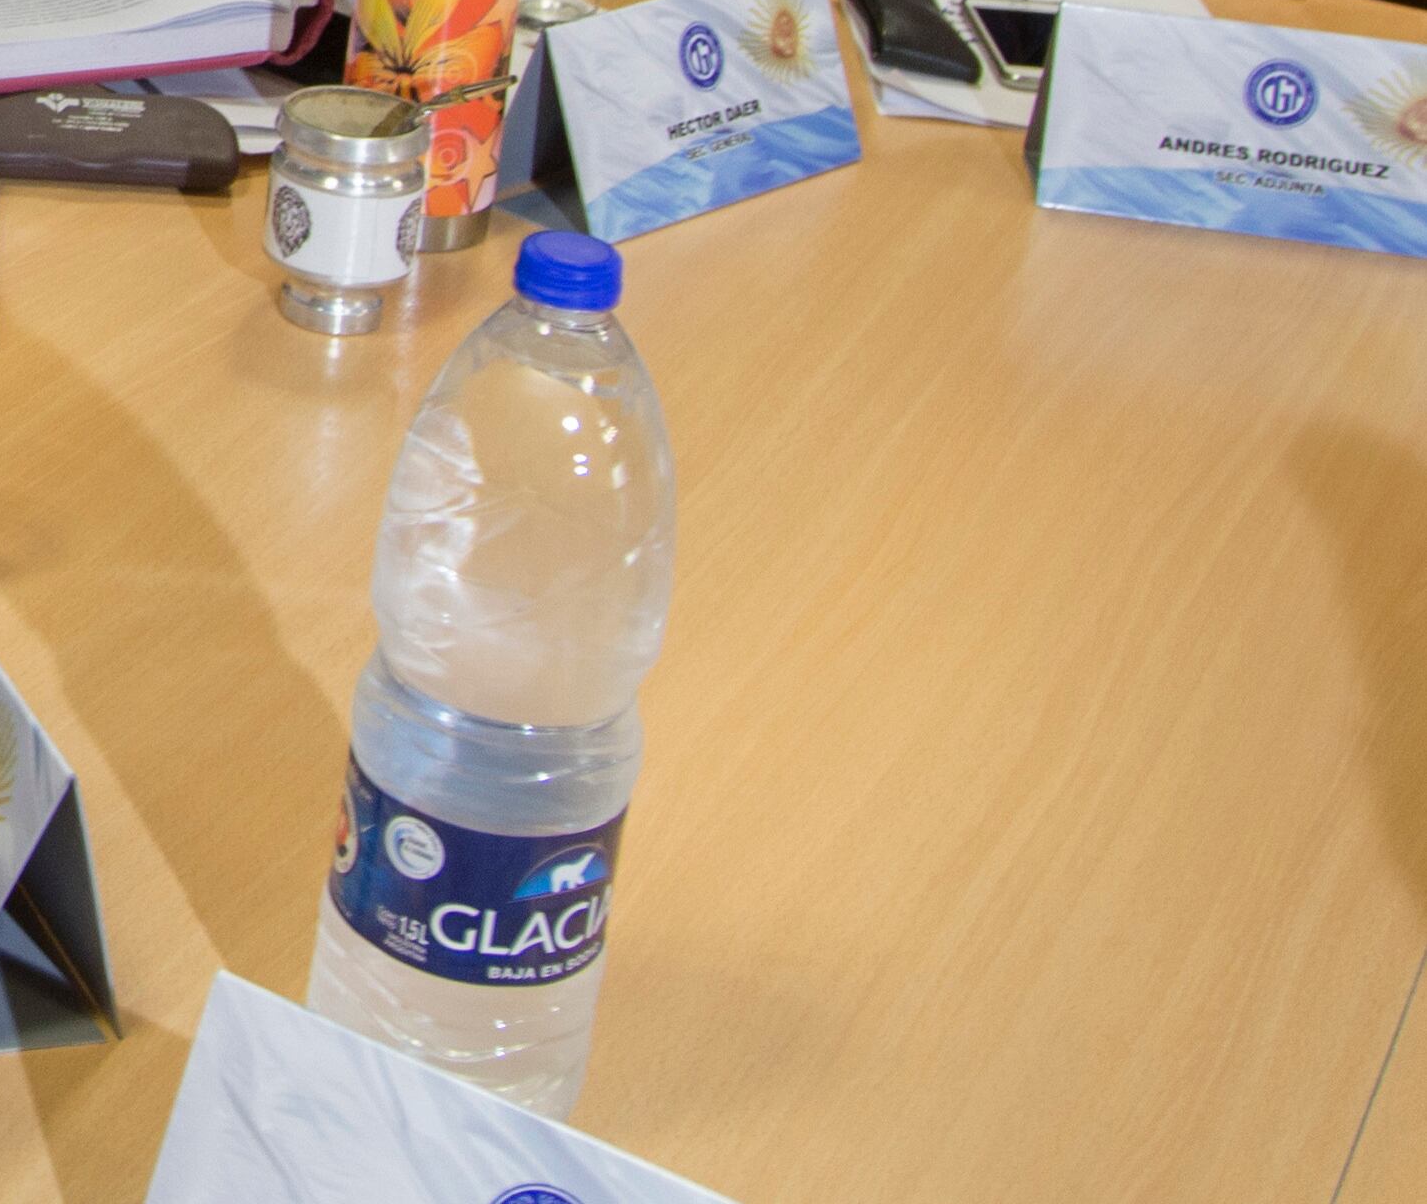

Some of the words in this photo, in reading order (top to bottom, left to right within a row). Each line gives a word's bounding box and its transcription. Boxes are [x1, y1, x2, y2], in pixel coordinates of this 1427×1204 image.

[667, 111, 723, 140] HECTOR
[725, 99, 761, 122] DAER
[1159, 136, 1249, 160] ANDRES
[1257, 148, 1390, 179] RODRIGUEZ
[487, 966, 537, 980] BAJA
[540, 963, 563, 978] EN
